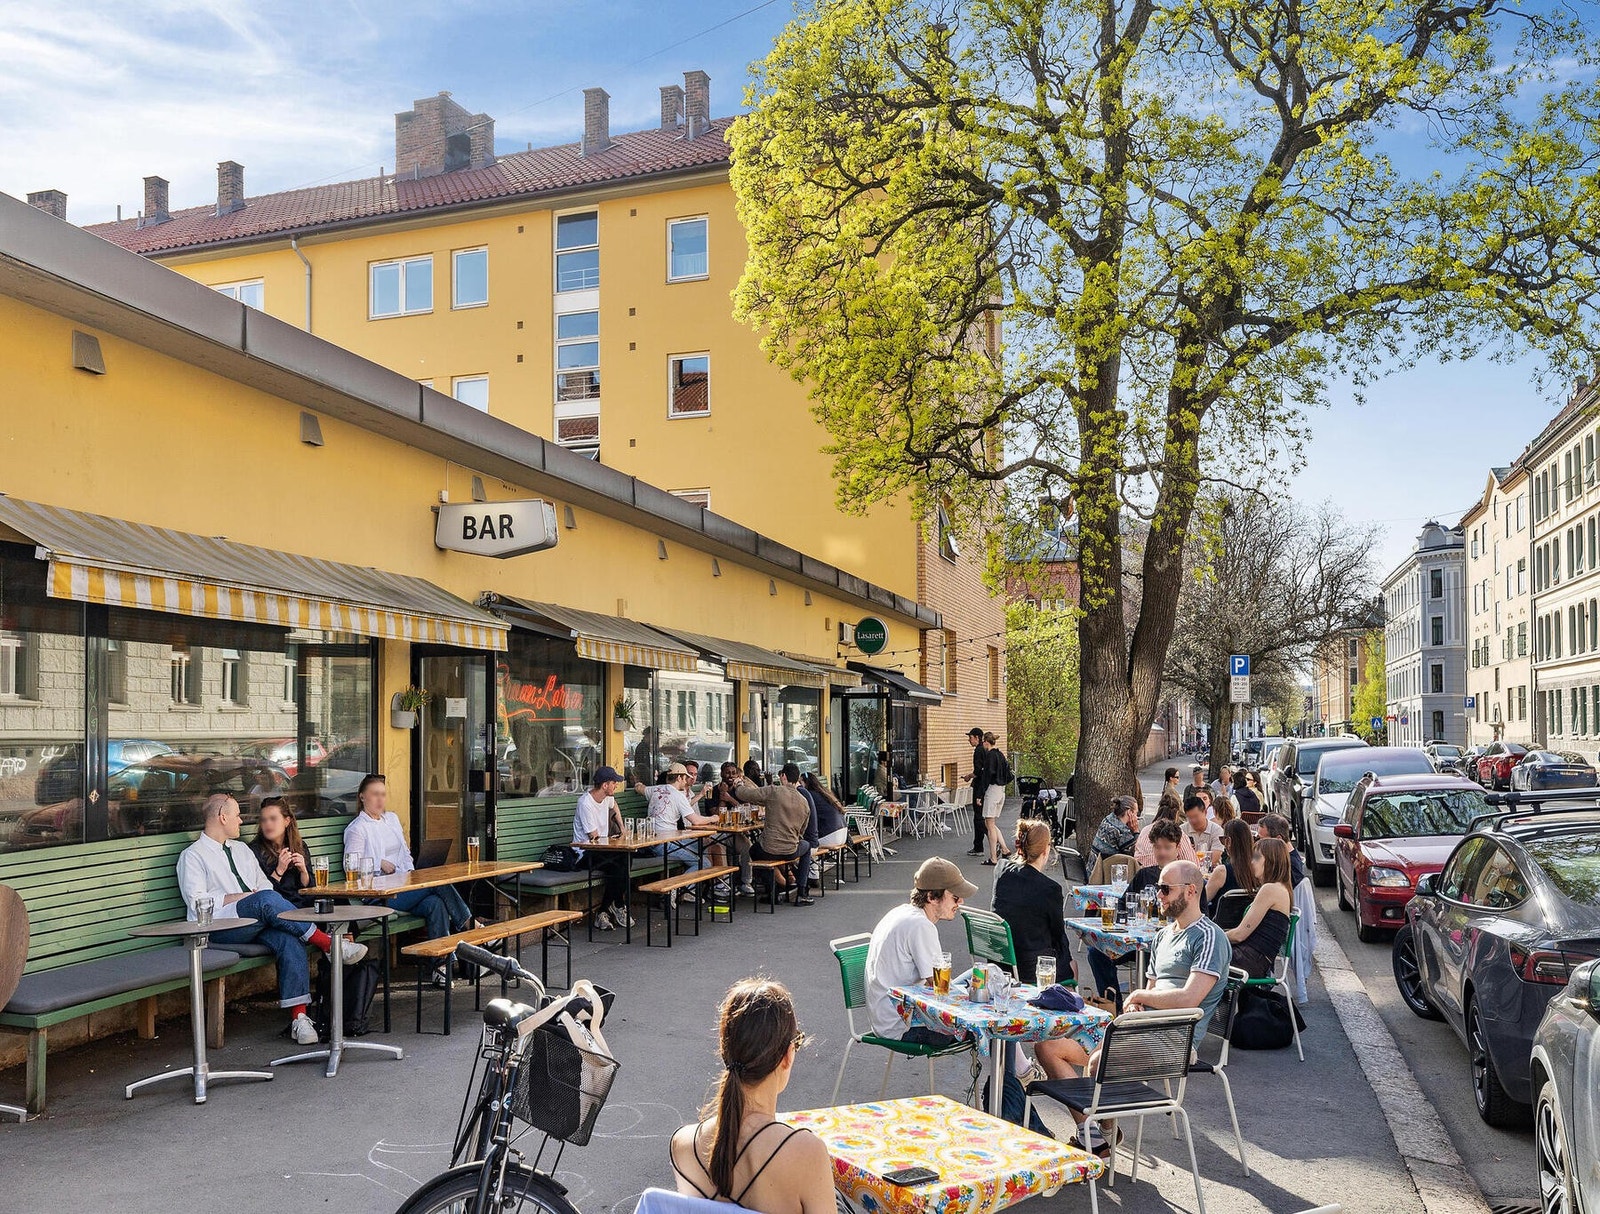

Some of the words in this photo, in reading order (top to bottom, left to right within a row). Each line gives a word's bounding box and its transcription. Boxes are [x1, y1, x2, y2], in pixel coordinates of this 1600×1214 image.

[462, 514, 514, 540] BAR
[857, 631, 884, 640] Lasarett
[1235, 658, 1245, 674] P
[1466, 698, 1473, 707] P
